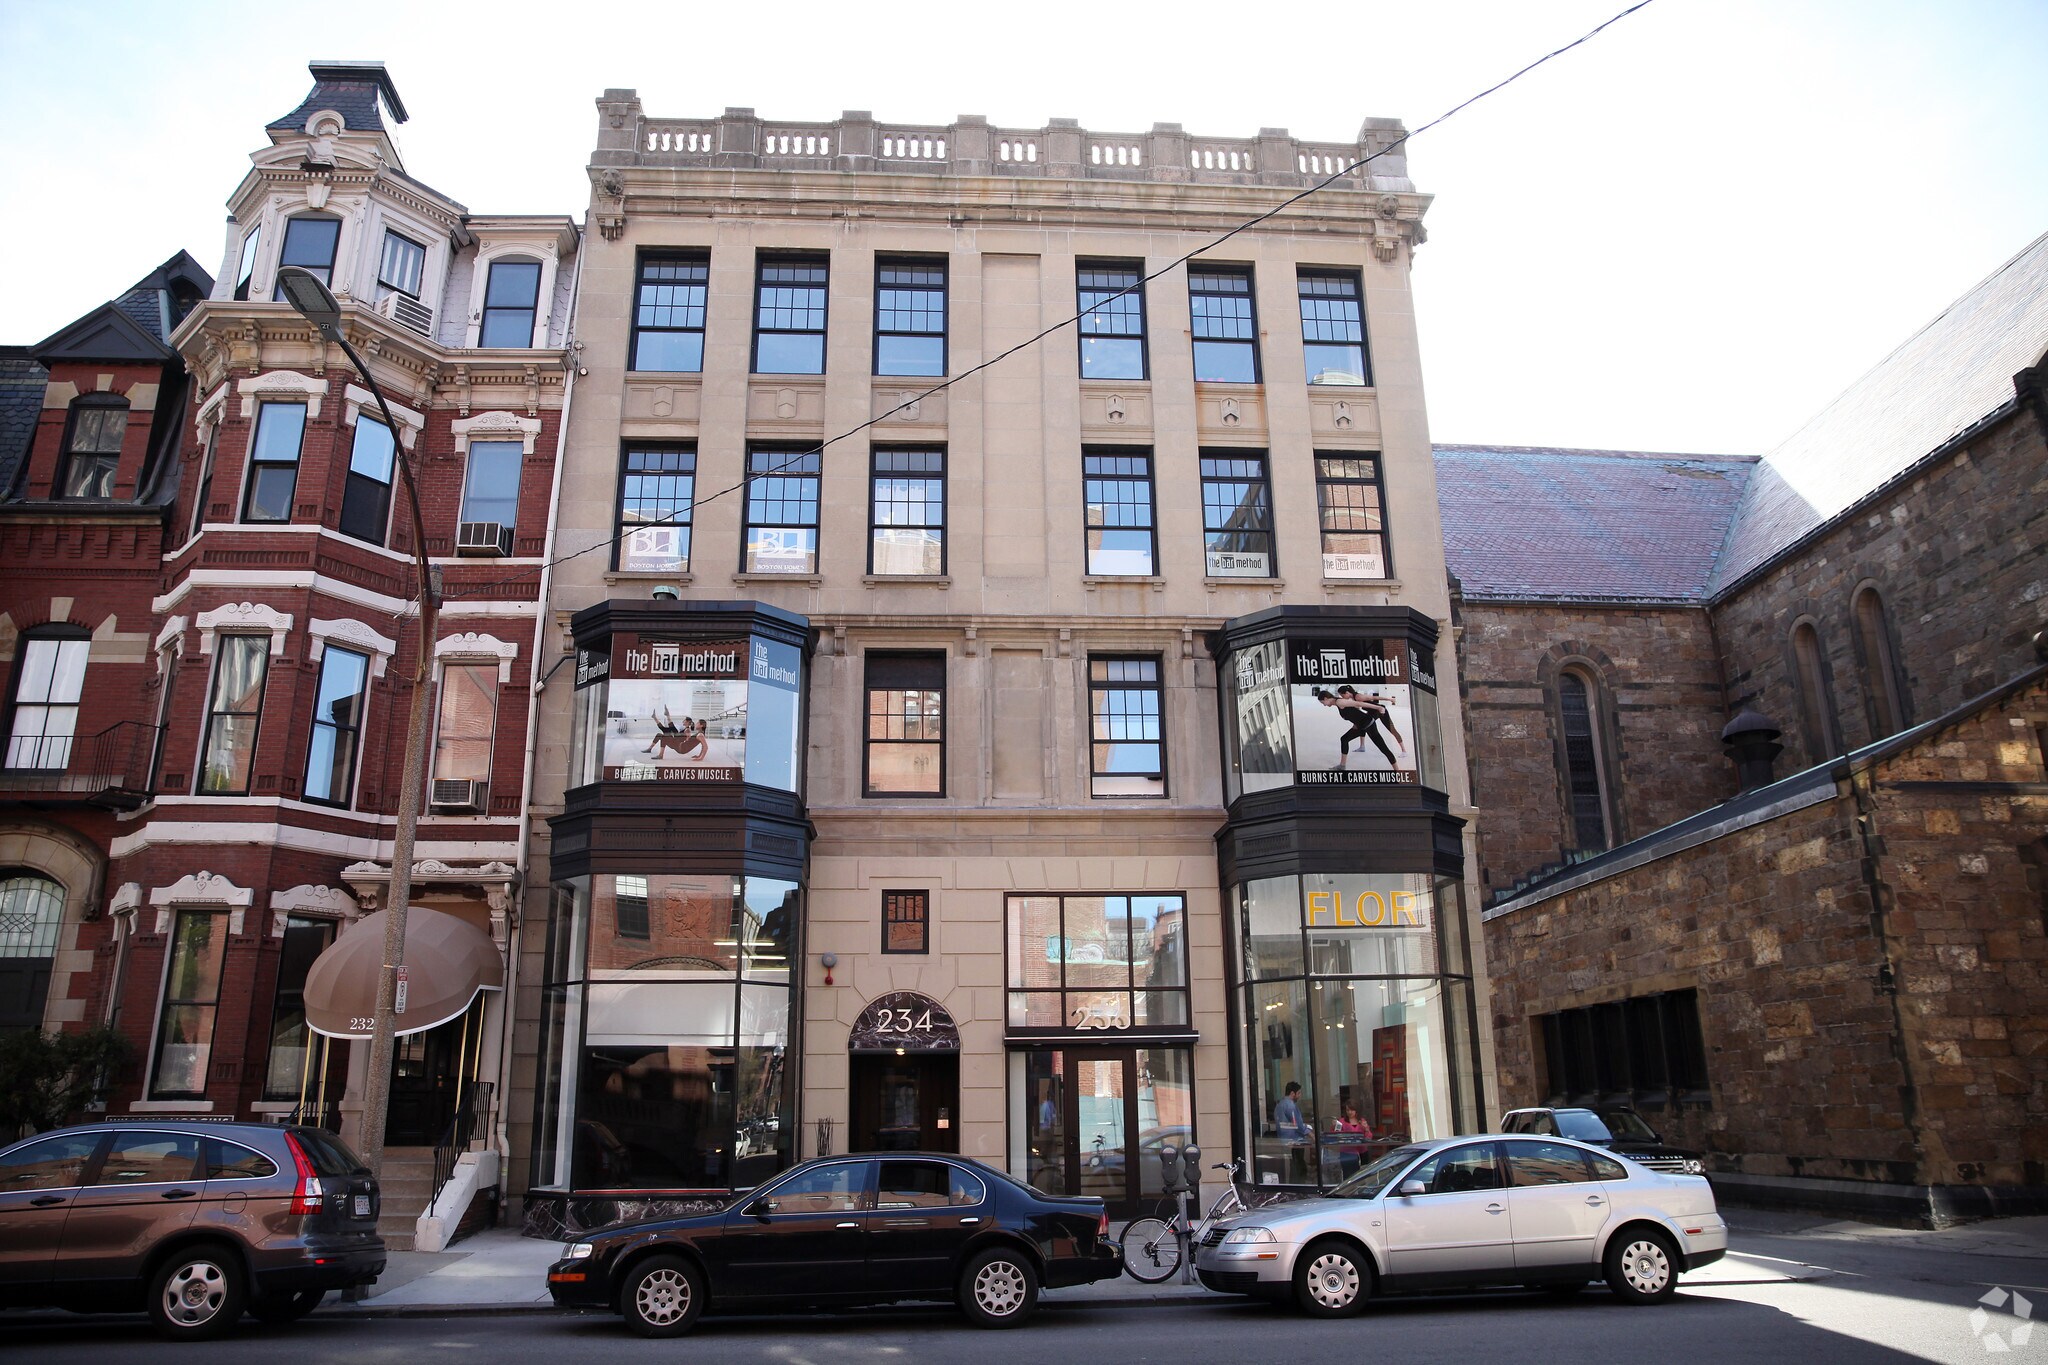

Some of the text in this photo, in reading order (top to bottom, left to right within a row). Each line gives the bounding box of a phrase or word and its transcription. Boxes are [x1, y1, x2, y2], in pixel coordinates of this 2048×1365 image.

[1208, 556, 1262, 569] the bar method
[1323, 558, 1376, 570] the bar method
[580, 650, 589, 665] the
[754, 641, 768, 659] the
[588, 659, 609, 680] method
[625, 648, 736, 674] the bar method
[1239, 654, 1252, 670] the
[1296, 652, 1400, 679] the bar method
[753, 658, 796, 685] bar method
[1239, 664, 1284, 690] bar method
[614, 768, 642, 780] BURNS
[663, 769, 696, 780] CARVES
[697, 769, 733, 780] MUSCLE.
[1301, 771, 1413, 783] BURNS FAT. CARVES MUSCLE.
[1307, 890, 1418, 927] FLOR
[350, 1017, 374, 1030] 232
[876, 1008, 933, 1033] 234
